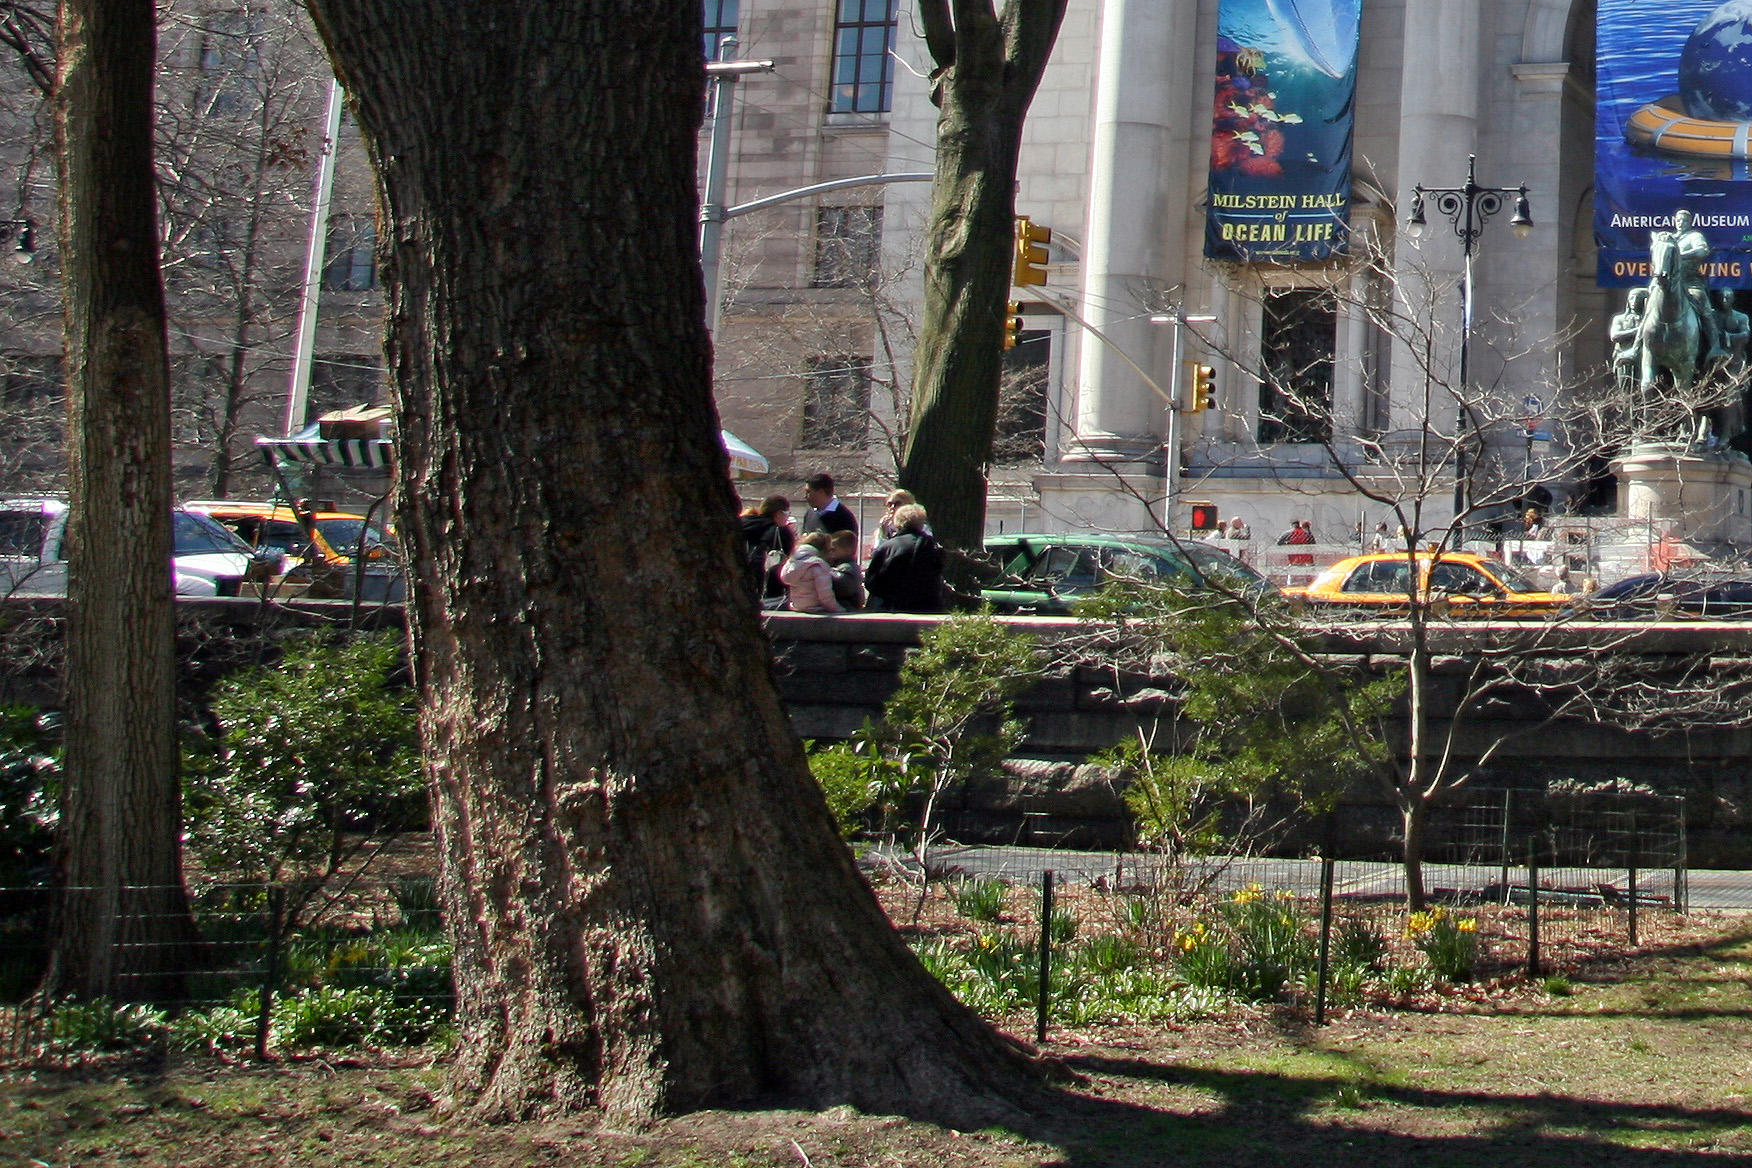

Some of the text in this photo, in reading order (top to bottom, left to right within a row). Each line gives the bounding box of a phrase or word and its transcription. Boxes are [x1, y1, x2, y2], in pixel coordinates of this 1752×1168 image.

[1213, 192, 1346, 209] MILSTEIN HALL
[1274, 210, 1289, 223] of
[1222, 223, 1333, 242] OCEAN LIFE
